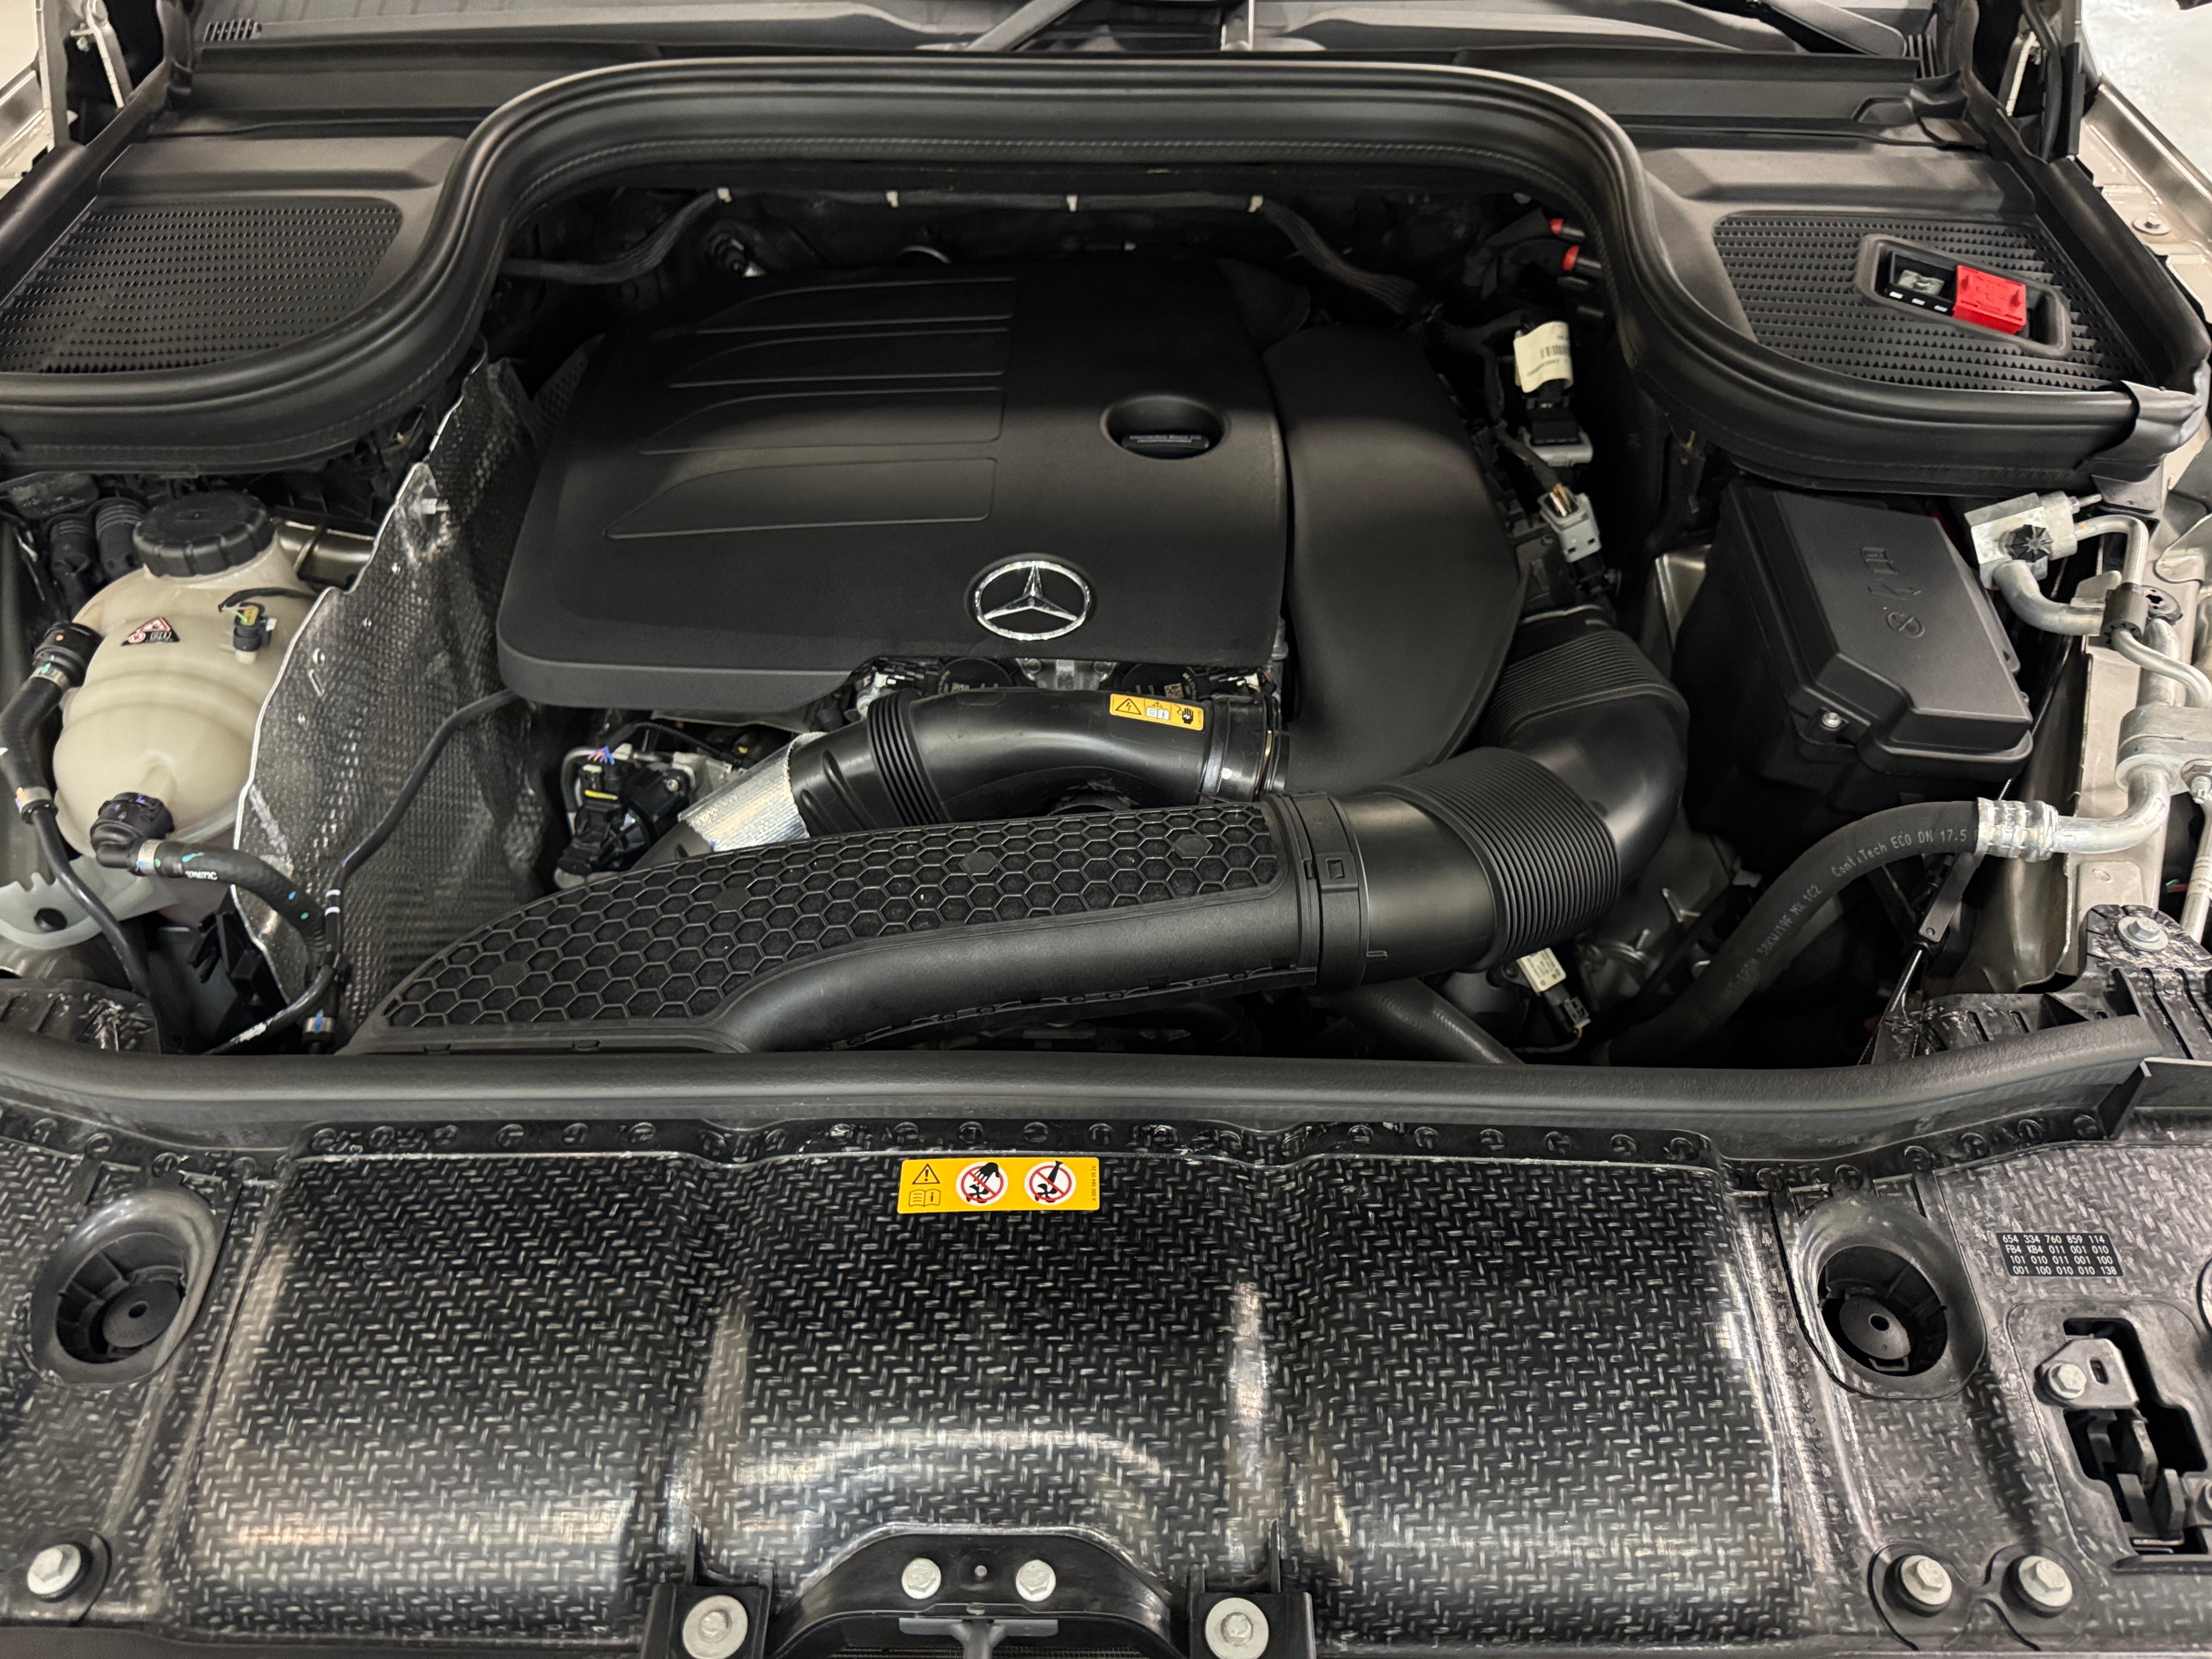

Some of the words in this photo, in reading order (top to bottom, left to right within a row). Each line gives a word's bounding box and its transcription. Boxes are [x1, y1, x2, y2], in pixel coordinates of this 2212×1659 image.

[1831, 843, 1887, 877] ContiTech
[1890, 832, 1912, 849] ECO
[1918, 830, 1933, 844] DN
[1940, 829, 1967, 843] 17.5
[2002, 1235, 2019, 1243] 654
[2023, 1235, 2040, 1243] 334
[2044, 1235, 2062, 1243] 760
[2066, 1235, 2083, 1243] 859
[2089, 1235, 2105, 1243] 114
[2005, 1245, 2022, 1254] FB4
[2027, 1245, 2044, 1254] KB4
[2049, 1245, 2066, 1254] 011
[2070, 1245, 2086, 1254] 001
[2092, 1245, 2109, 1254] 010
[2010, 1256, 2025, 1264] 101
[2030, 1256, 2048, 1264] 010
[2052, 1256, 2069, 1264] 011
[2074, 1256, 2091, 1264] 001
[2096, 1256, 2113, 1264] 100
[2013, 1266, 2029, 1275] 001
[2035, 1266, 2051, 1275] 100
[2056, 1266, 2073, 1275] 010
[2078, 1266, 2095, 1275] 010
[2100, 1266, 2117, 1275] 138
